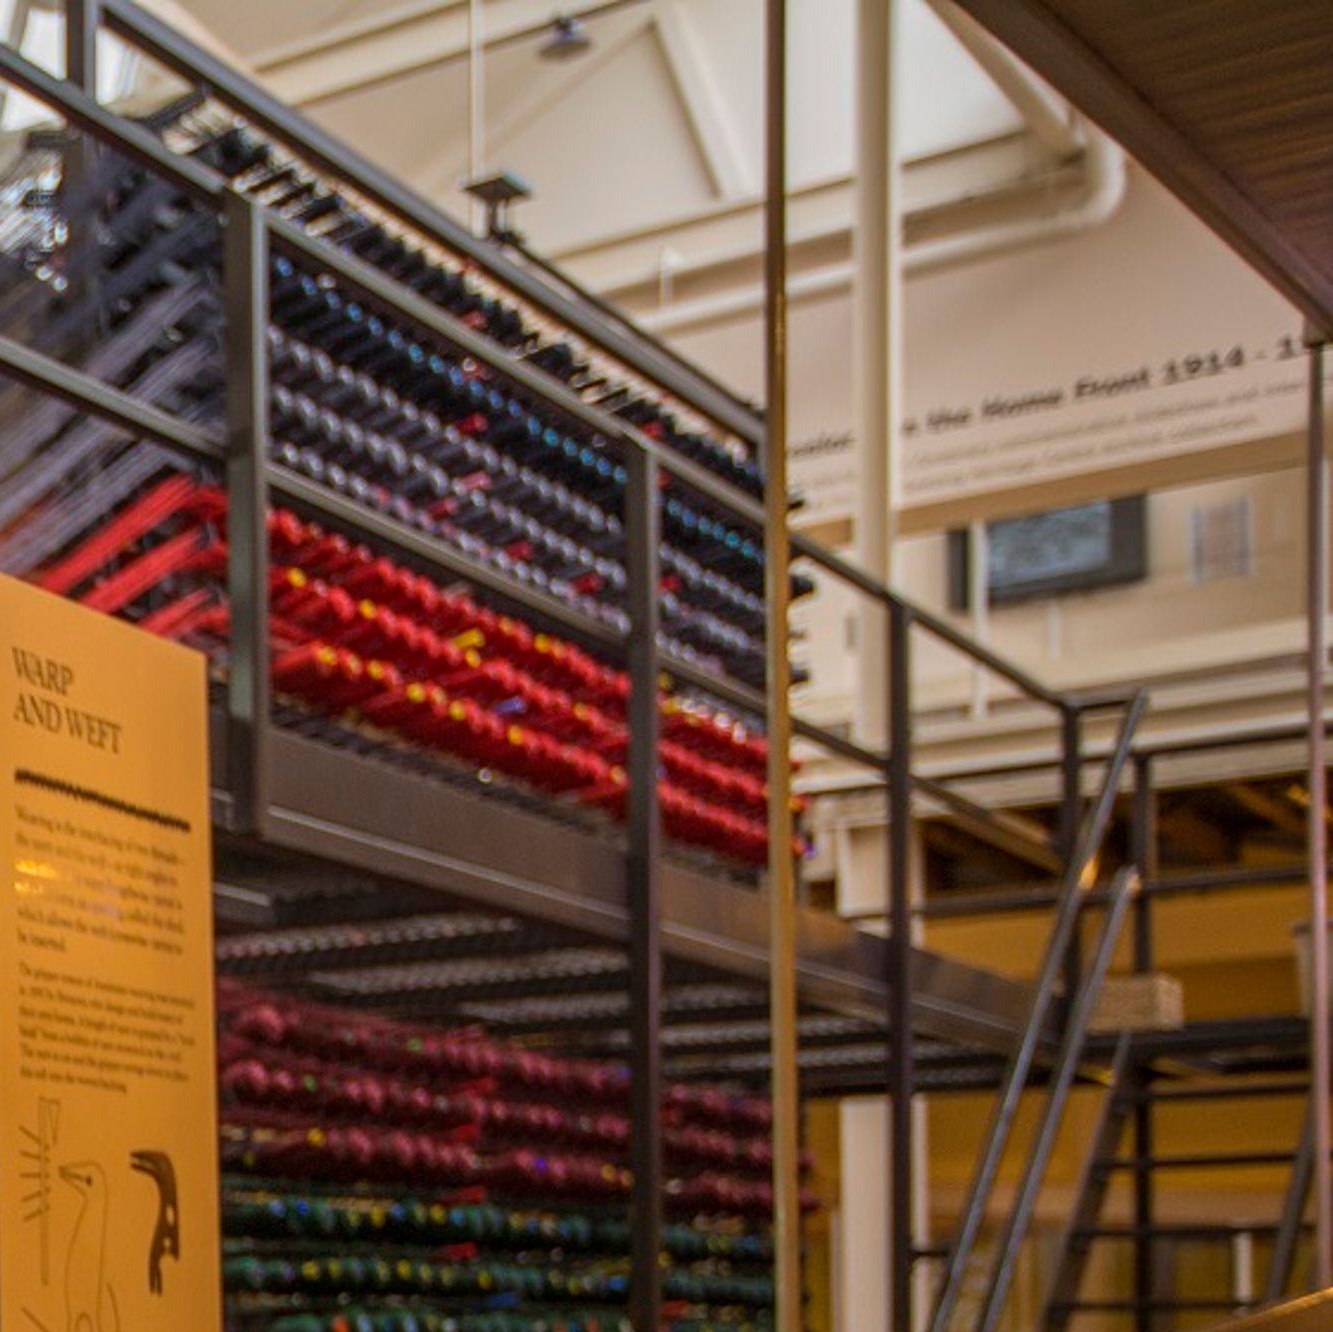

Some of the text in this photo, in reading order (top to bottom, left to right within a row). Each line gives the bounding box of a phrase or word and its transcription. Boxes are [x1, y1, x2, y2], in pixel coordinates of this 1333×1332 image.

[1162, 344, 1245, 385] 1914
[12, 647, 74, 697] WARP
[13, 693, 122, 755] AND WEFT
